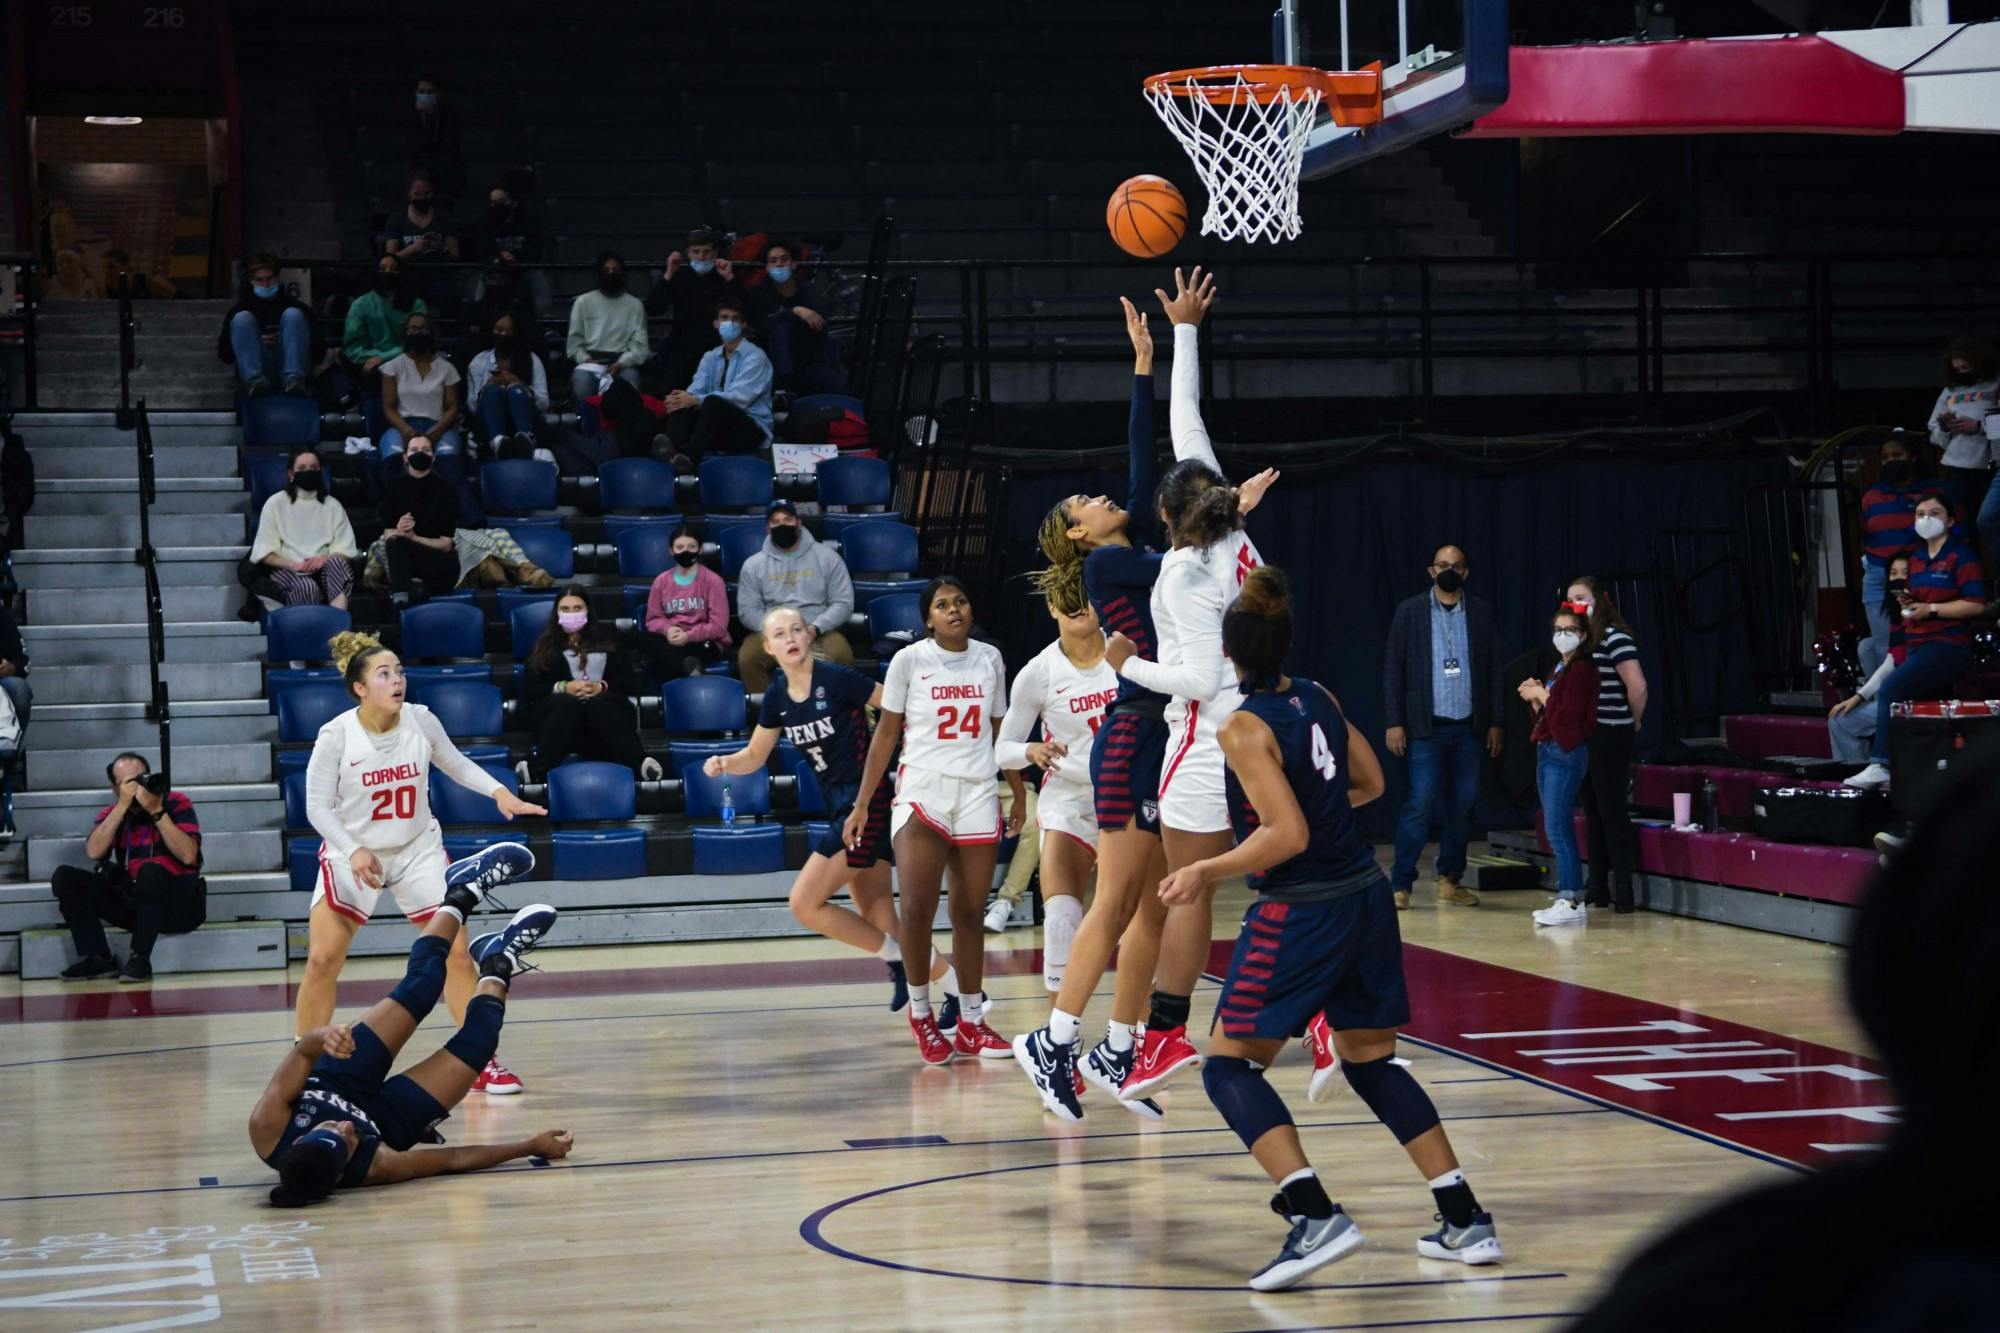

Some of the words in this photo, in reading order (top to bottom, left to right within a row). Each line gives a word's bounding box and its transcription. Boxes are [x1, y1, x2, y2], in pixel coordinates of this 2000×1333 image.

[50, 5, 94, 26] 215
[143, 7, 185, 28] 216
[931, 684, 984, 700] CORNELL
[1069, 687, 1119, 714] CORNE
[937, 704, 981, 740] 24
[1087, 713, 1109, 737] 1
[1311, 722, 1336, 781] 4
[361, 761, 421, 787] CORNELL
[371, 784, 417, 821] 20
[241, 1247, 321, 1284] THE
